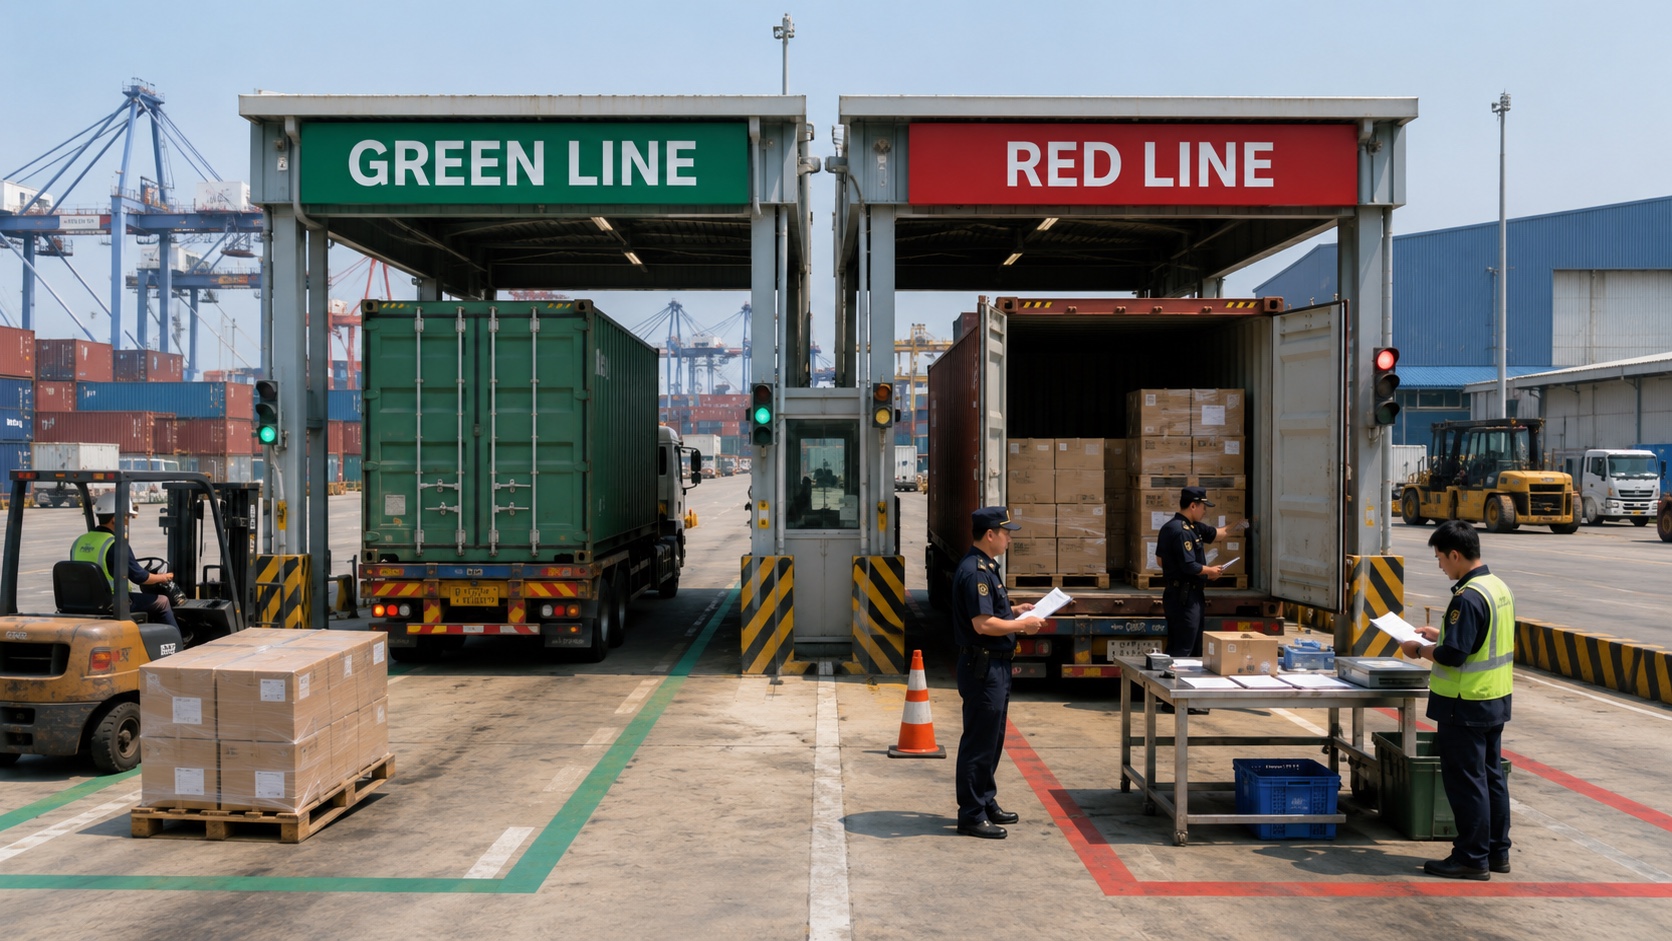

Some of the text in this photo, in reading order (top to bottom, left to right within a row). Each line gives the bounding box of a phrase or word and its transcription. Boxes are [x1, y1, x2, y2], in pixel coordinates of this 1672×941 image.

[349, 140, 697, 187] GREEN LINE
[1008, 141, 1274, 188] RED LINE
